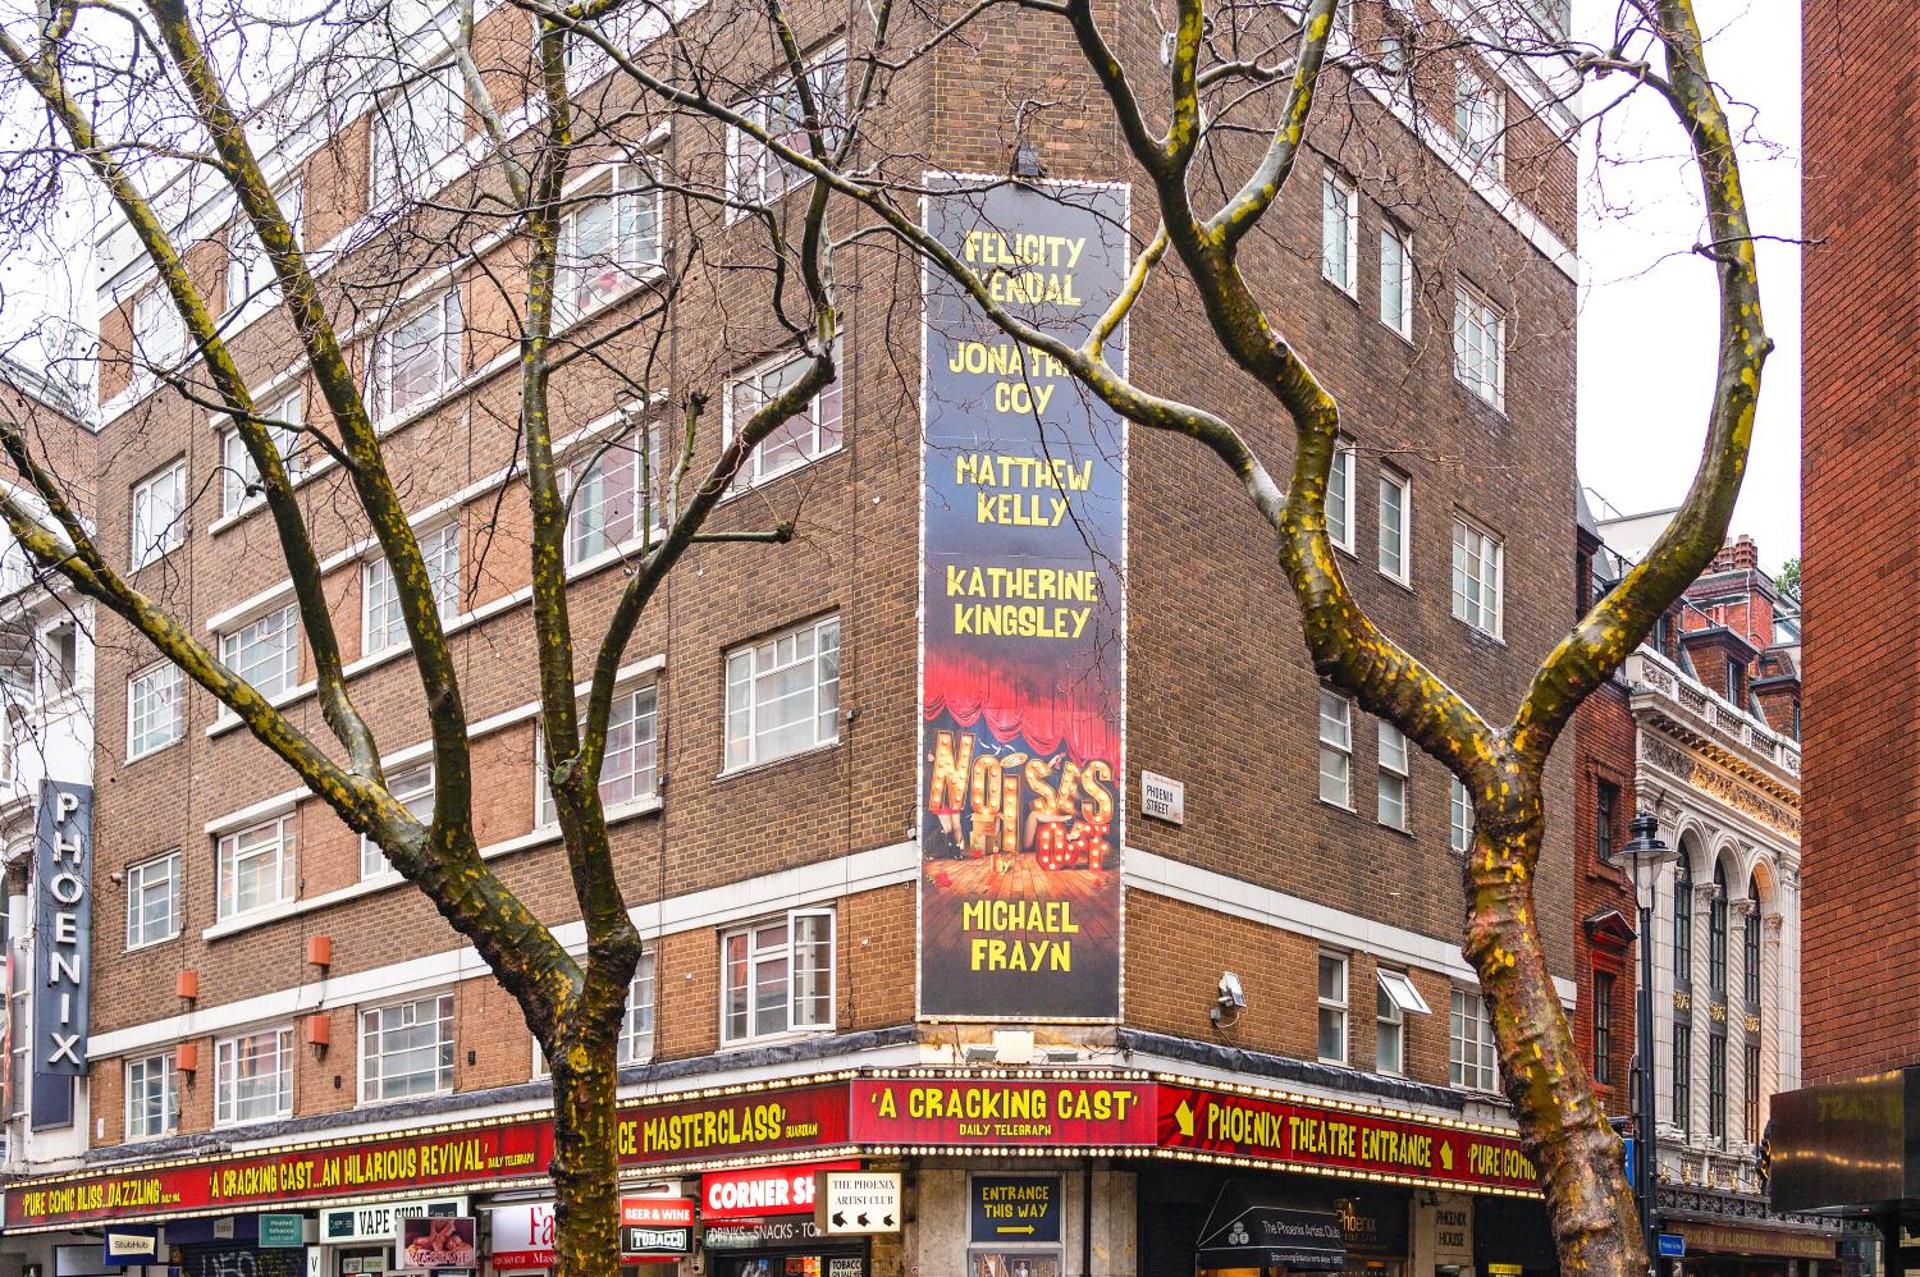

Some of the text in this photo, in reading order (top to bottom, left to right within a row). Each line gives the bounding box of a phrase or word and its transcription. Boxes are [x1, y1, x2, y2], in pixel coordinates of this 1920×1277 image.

[966, 230, 1086, 268] FELICITY
[950, 341, 1075, 377] JONATH
[995, 382, 1055, 415] COY
[956, 454, 1093, 492] MATTHEW
[977, 492, 1071, 527] KELLY
[946, 565, 1099, 602] KATHERINE
[954, 603, 1091, 639] KINGSLEY
[1146, 785, 1173, 802] PHOENIX
[1146, 798, 1169, 815] STREET
[48, 792, 83, 1065] PHOENIX
[962, 900, 1079, 933] MICHAEL
[971, 939, 1071, 972] FRAYN
[909, 1087, 1047, 1120] CRACKING
[1058, 1090, 1138, 1121] CAST'
[643, 1103, 786, 1153] MASTERCLASS'
[786, 1123, 818, 1138] GUARDIAN
[959, 1123, 1052, 1137] DAILY TELEGRAPH
[1206, 1102, 1432, 1169] PHOENIX THEATRE ENTRANCE
[223, 1165, 277, 1197] CRACKING
[344, 1147, 416, 1185] HILARIOUS
[421, 1138, 488, 1177] REVIVAL'
[488, 1156, 503, 1168] DAILY
[505, 1152, 535, 1167] TELEGRAPH
[708, 1179, 790, 1210] CORNER
[832, 1180, 895, 1190] THE PHOENIX
[982, 1186, 1049, 1201] ENTRANCE
[49, 1187, 75, 1214] COMIC
[624, 1207, 691, 1221] BEER & WINE
[836, 1196, 893, 1205] ARTIST CLUB
[984, 1203, 1048, 1218] THIS WAY
[358, 1208, 390, 1235] VAPE
[753, 1223, 793, 1240] SNACKS
[1261, 1220, 1277, 1234] The
[114, 1239, 149, 1250] StubHub
[633, 1230, 684, 1248] TOBACCO
[1438, 1231, 1464, 1247] HOUSE
[832, 1259, 862, 1270] TOBACC
